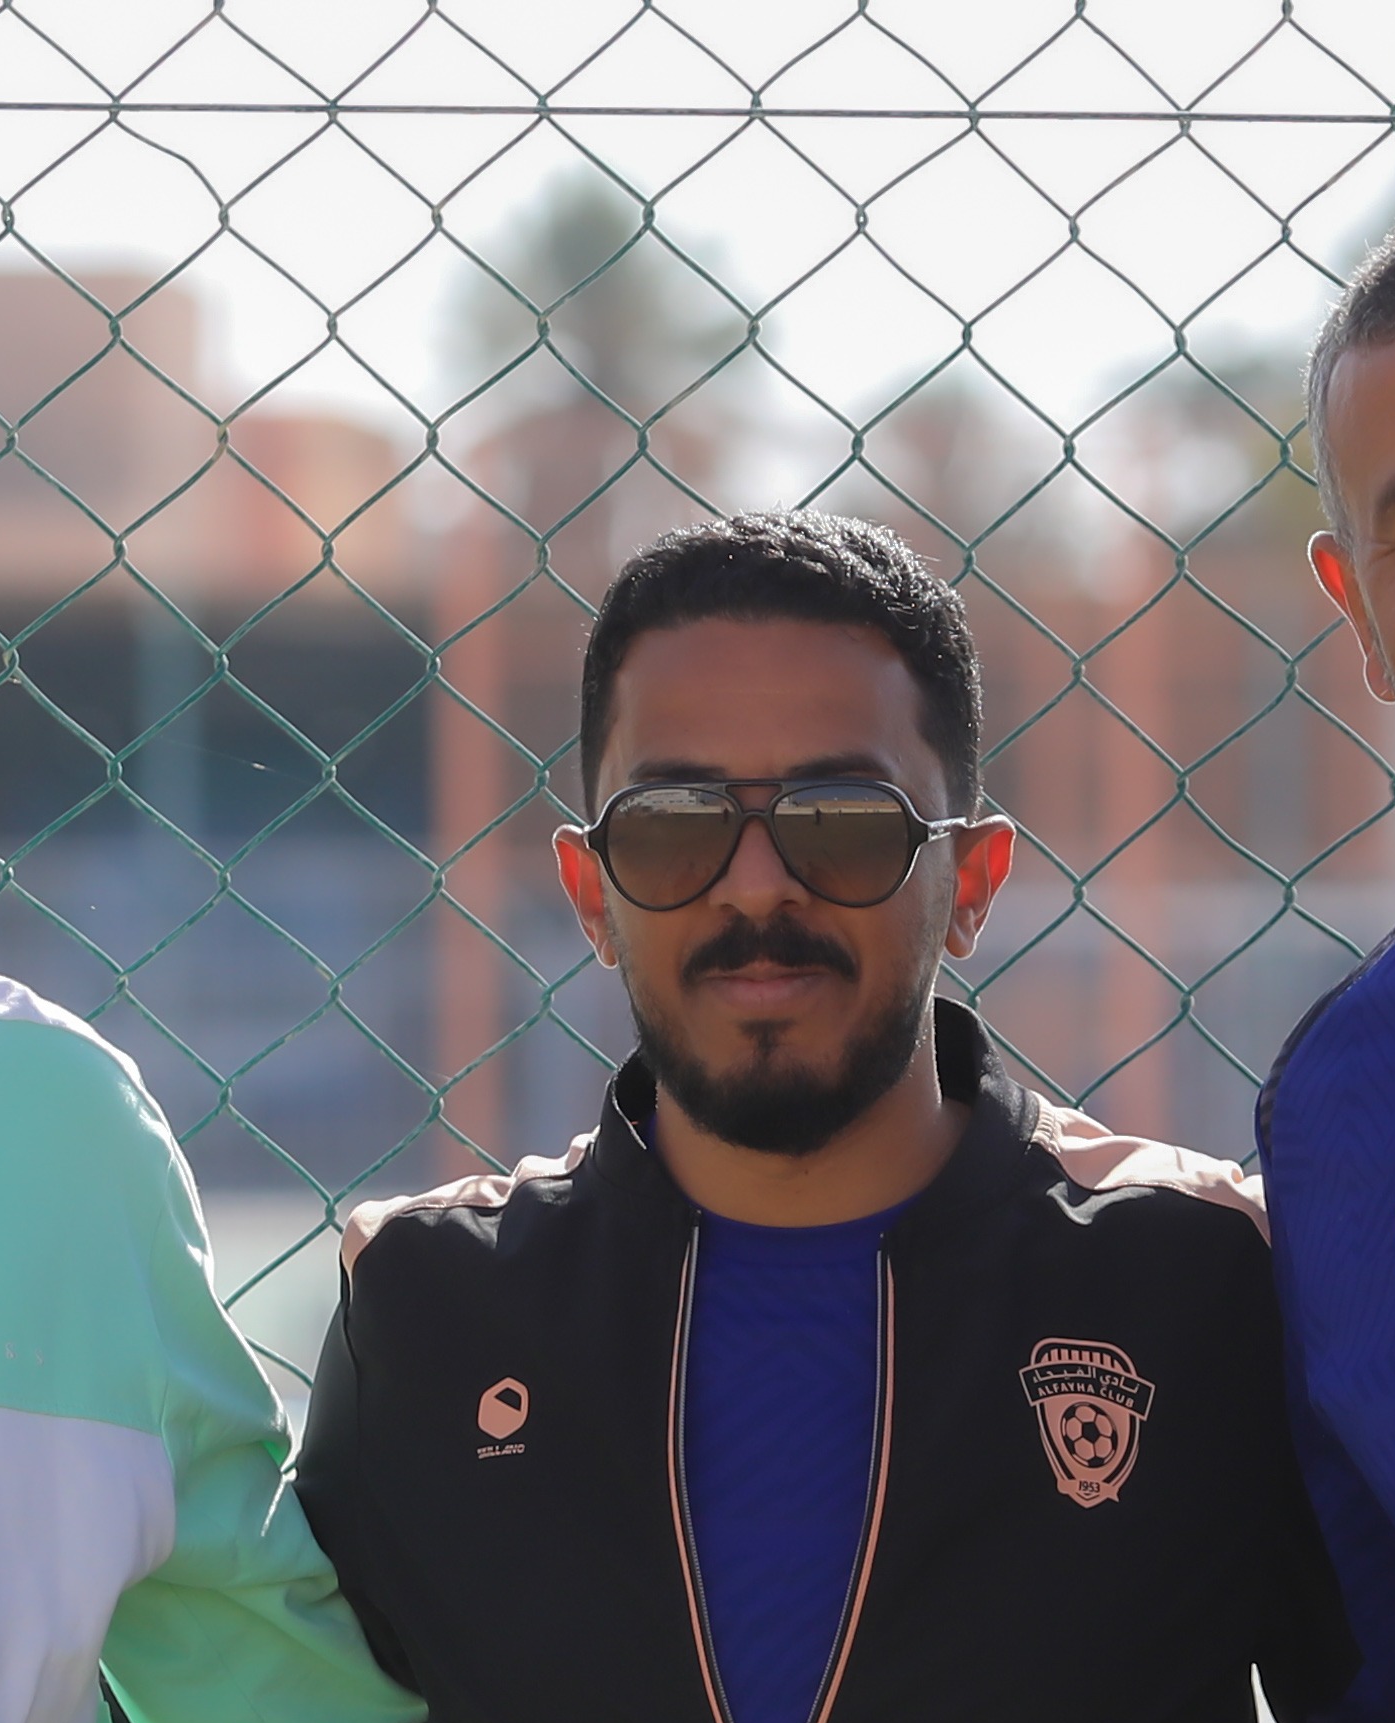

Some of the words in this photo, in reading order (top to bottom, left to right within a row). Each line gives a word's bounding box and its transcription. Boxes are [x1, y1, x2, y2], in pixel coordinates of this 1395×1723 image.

[1037, 1381, 1096, 1397] ALFAYHA
[1099, 1386, 1135, 1408] CLUB
[1078, 1480, 1101, 1493] 1953
